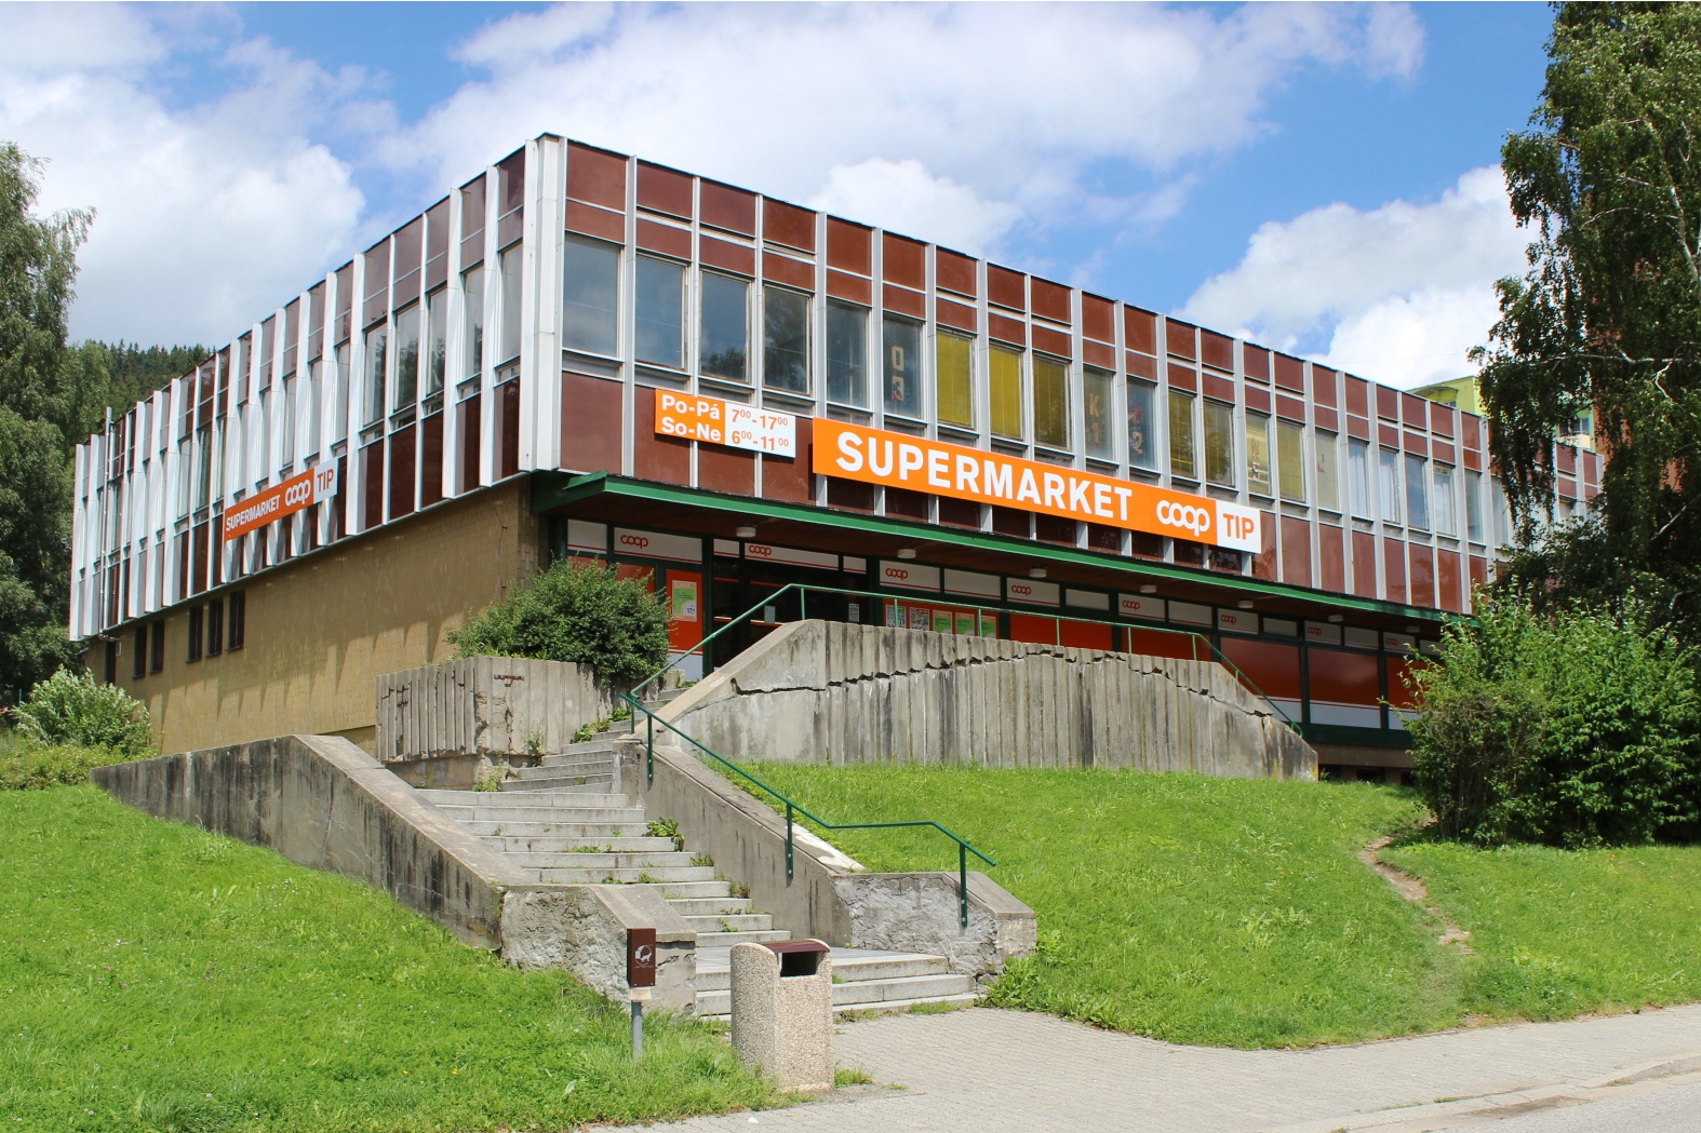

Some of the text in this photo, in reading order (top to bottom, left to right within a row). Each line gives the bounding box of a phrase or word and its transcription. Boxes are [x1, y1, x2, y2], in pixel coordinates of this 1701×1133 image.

[661, 394, 721, 420] Po-Pá
[661, 417, 722, 441] So-Ne
[835, 431, 1255, 540] SUPERMARKET coop TIP
[226, 468, 335, 532] SUPERMARKET coop TIP
[620, 534, 649, 549] coop
[748, 544, 772, 557] coop
[885, 567, 909, 581] coop
[1011, 584, 1032, 597] coop
[1122, 600, 1141, 612] coop
[1220, 614, 1237, 625] coop
